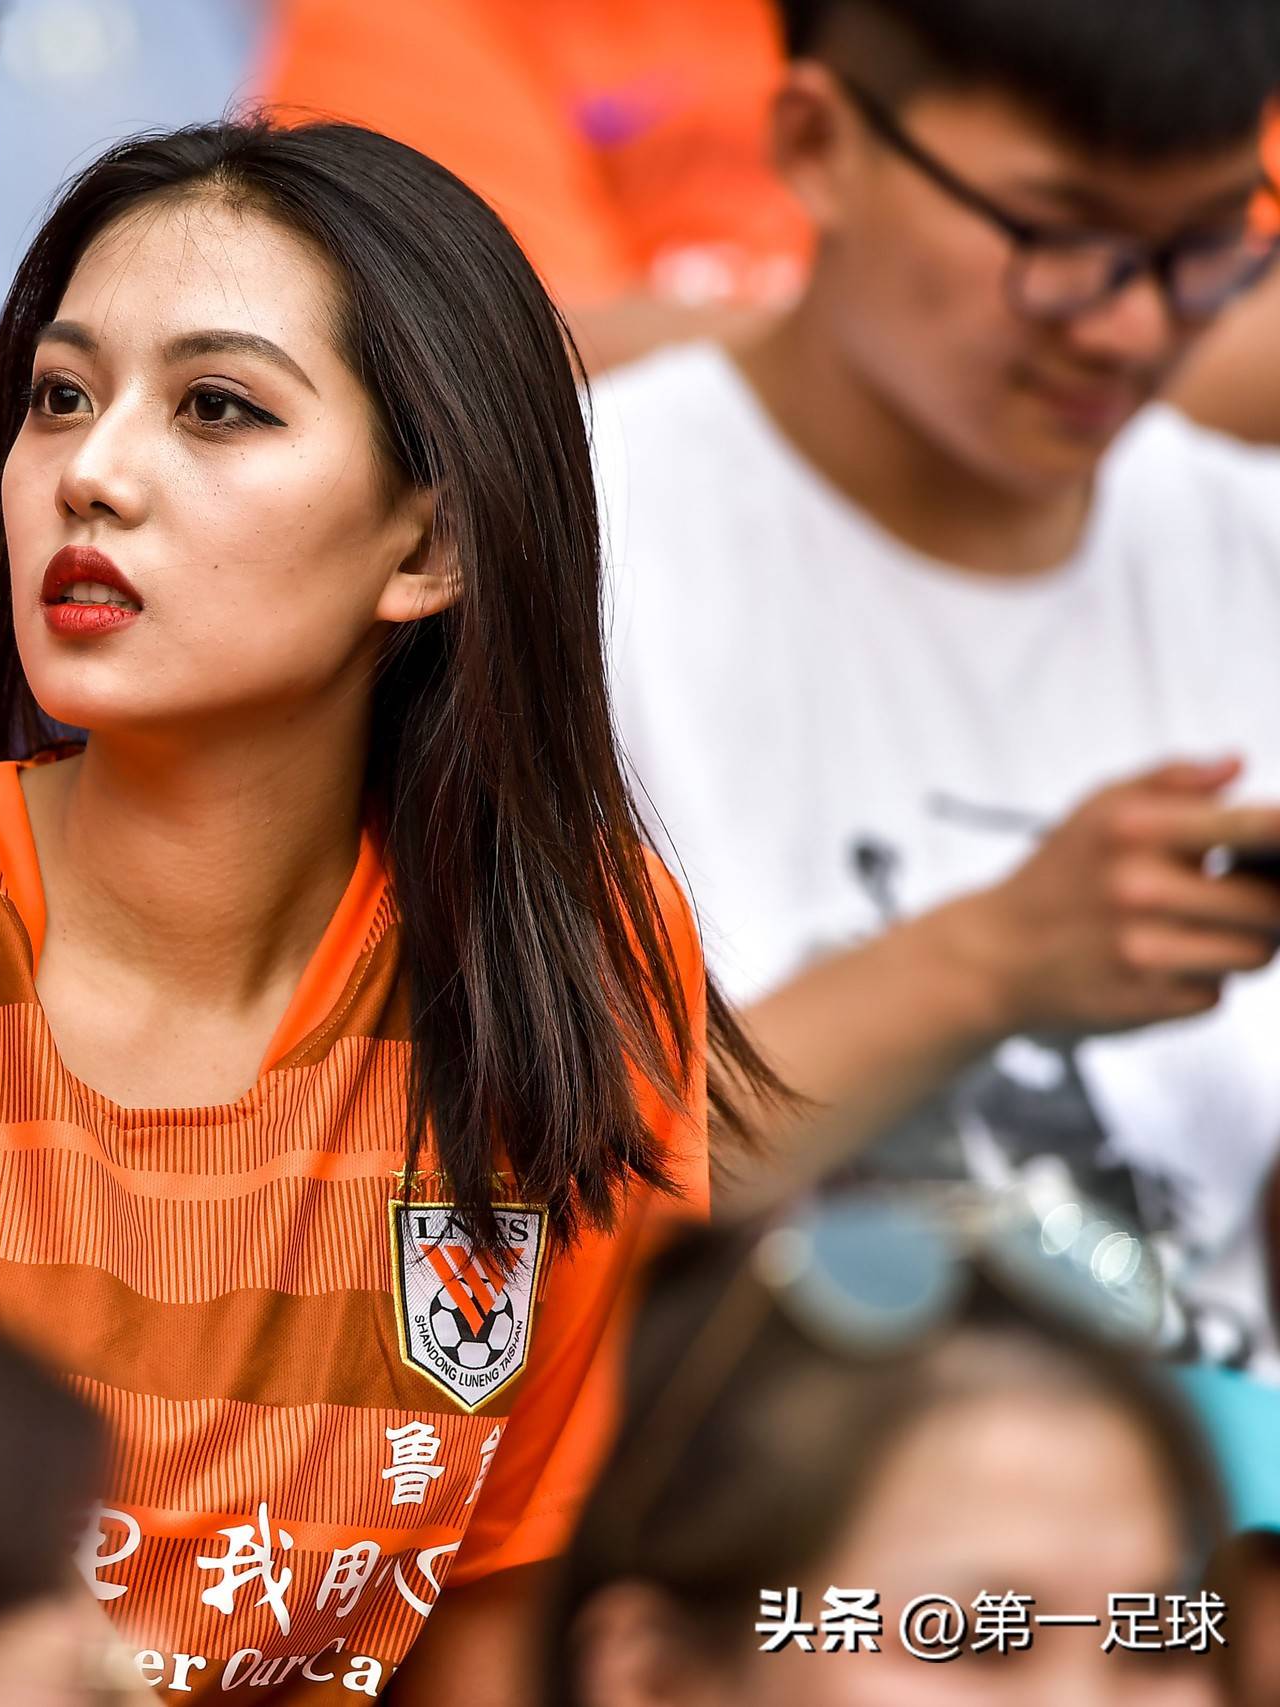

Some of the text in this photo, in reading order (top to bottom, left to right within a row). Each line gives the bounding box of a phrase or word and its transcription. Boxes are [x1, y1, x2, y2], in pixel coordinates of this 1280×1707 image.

[414, 1216, 529, 1242] LNS
[414, 1315, 523, 1388] SHANDONG LUNENG TAISHAN
